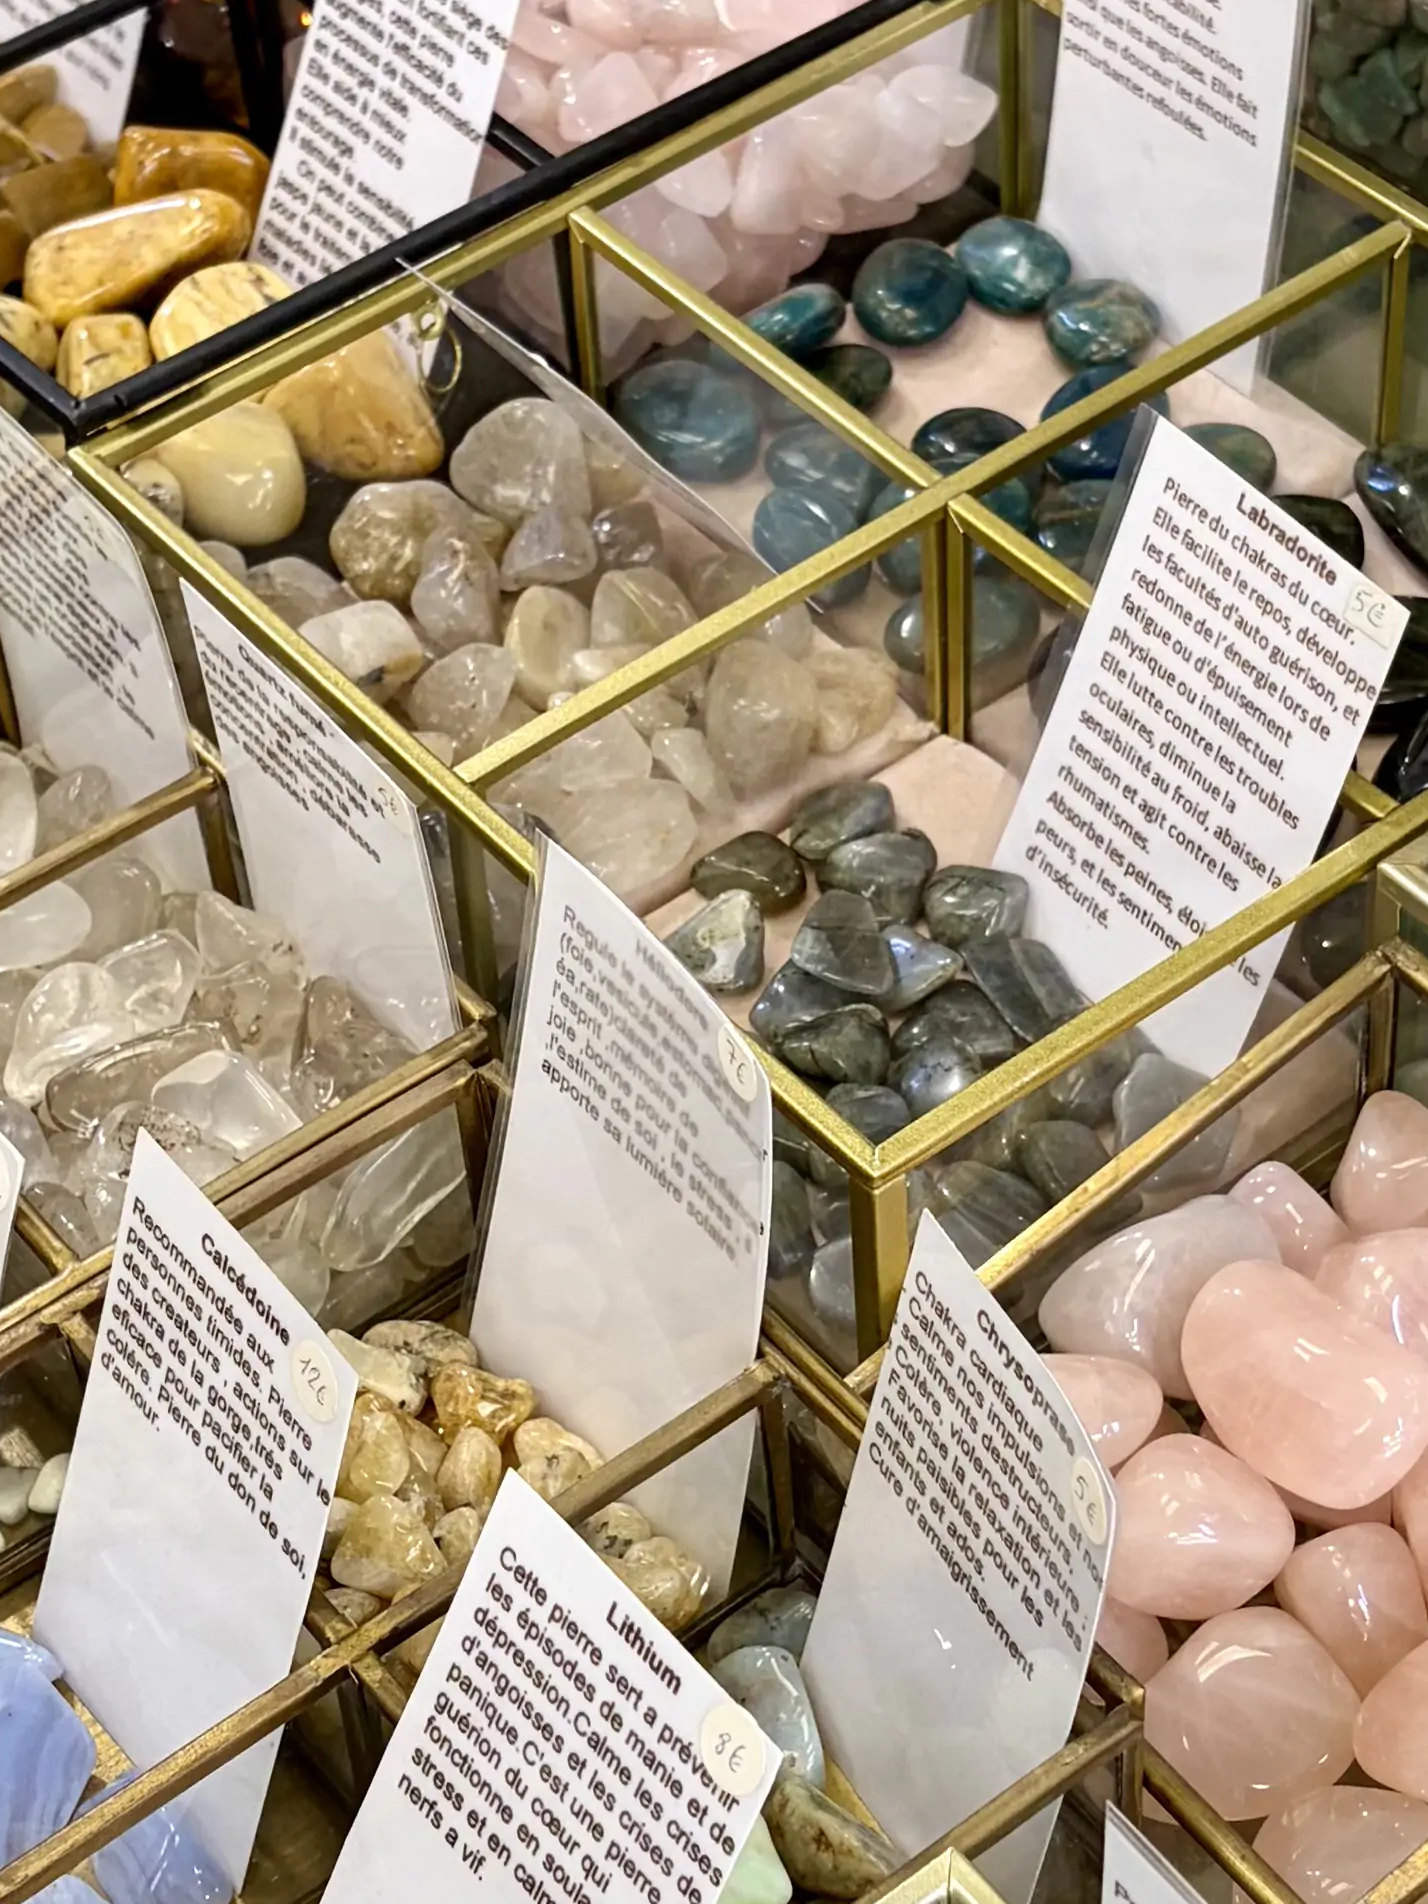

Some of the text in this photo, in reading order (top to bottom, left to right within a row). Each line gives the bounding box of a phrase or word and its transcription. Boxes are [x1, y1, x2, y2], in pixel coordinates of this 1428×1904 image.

[1162, 476, 1355, 646] Pierre du chakras du cœur.
[1236, 492, 1337, 586] Labradorite
[1351, 589, 1386, 629] 5€
[1109, 625, 1284, 781] physique ou intellectuel.
[542, 1058, 599, 1121] apporte
[132, 1195, 275, 1374] Recommandée aux
[201, 1233, 290, 1347] Calcédoine
[111, 1303, 274, 1503] eficace pour pacifier la
[915, 1271, 1044, 1453] Chakra cardiaque
[977, 1309, 1075, 1457] Chrysoprase
[868, 1441, 1034, 1682] Cure d'amaigrissement
[1074, 1474, 1097, 1526] 5€
[606, 1601, 682, 1695] Lithium
[433, 1691, 613, 1894] guérion du cœur qui
[714, 1732, 746, 1774] 8€
[397, 1773, 487, 1881] nerfs a vif.
